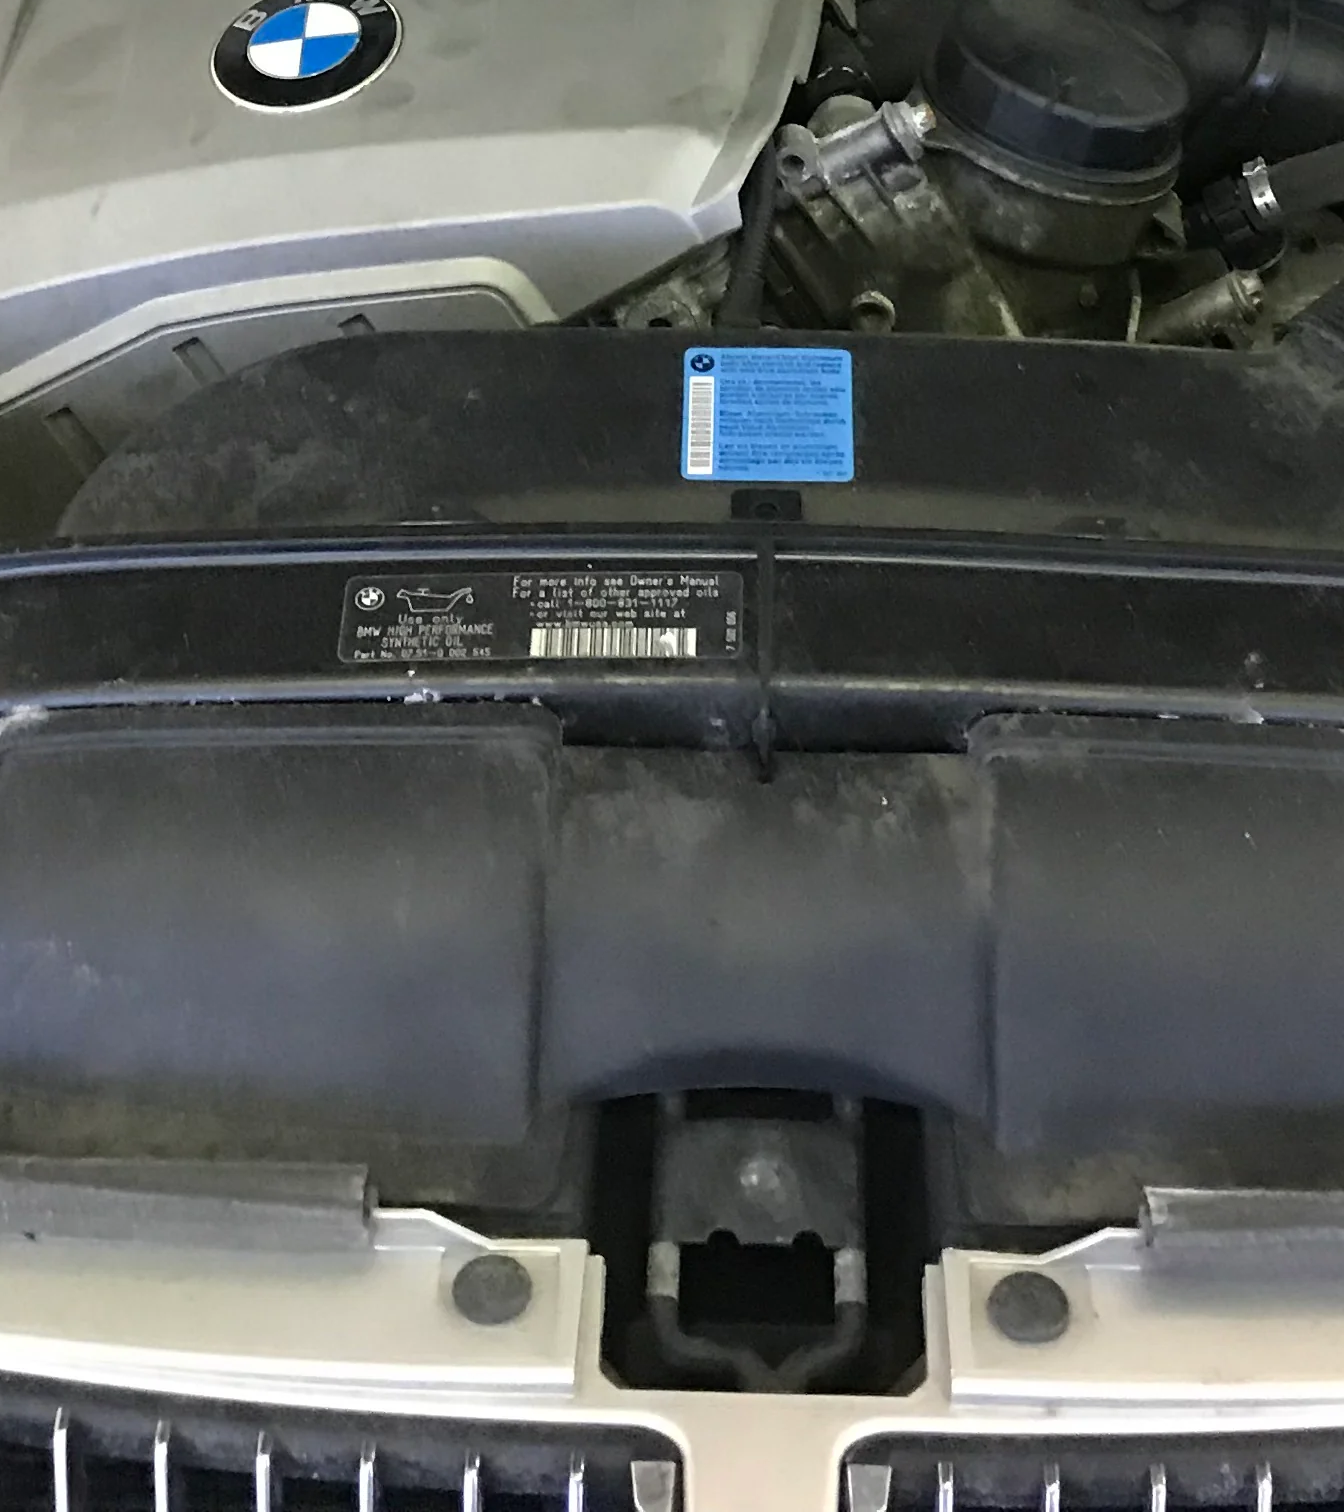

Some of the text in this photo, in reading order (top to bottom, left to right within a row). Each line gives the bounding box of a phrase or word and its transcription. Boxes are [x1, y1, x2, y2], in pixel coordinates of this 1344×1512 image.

[513, 575, 532, 587] For
[539, 578, 567, 587] more
[574, 575, 597, 587] info
[604, 578, 623, 587] see
[680, 574, 719, 587] Manual
[512, 587, 532, 599] For
[552, 587, 573, 598] list
[580, 586, 593, 598] of
[600, 587, 631, 598] other
[637, 586, 690, 599] approved
[696, 586, 719, 598] oils
[398, 613, 465, 626] Use only
[615, 608, 637, 619] web
[643, 608, 667, 619] site
[673, 608, 687, 619] at
[356, 622, 495, 638] BMW HIGH PERFORMANCE
[380, 635, 464, 648] SYNTHETIC OIL
[354, 649, 376, 659] Part
